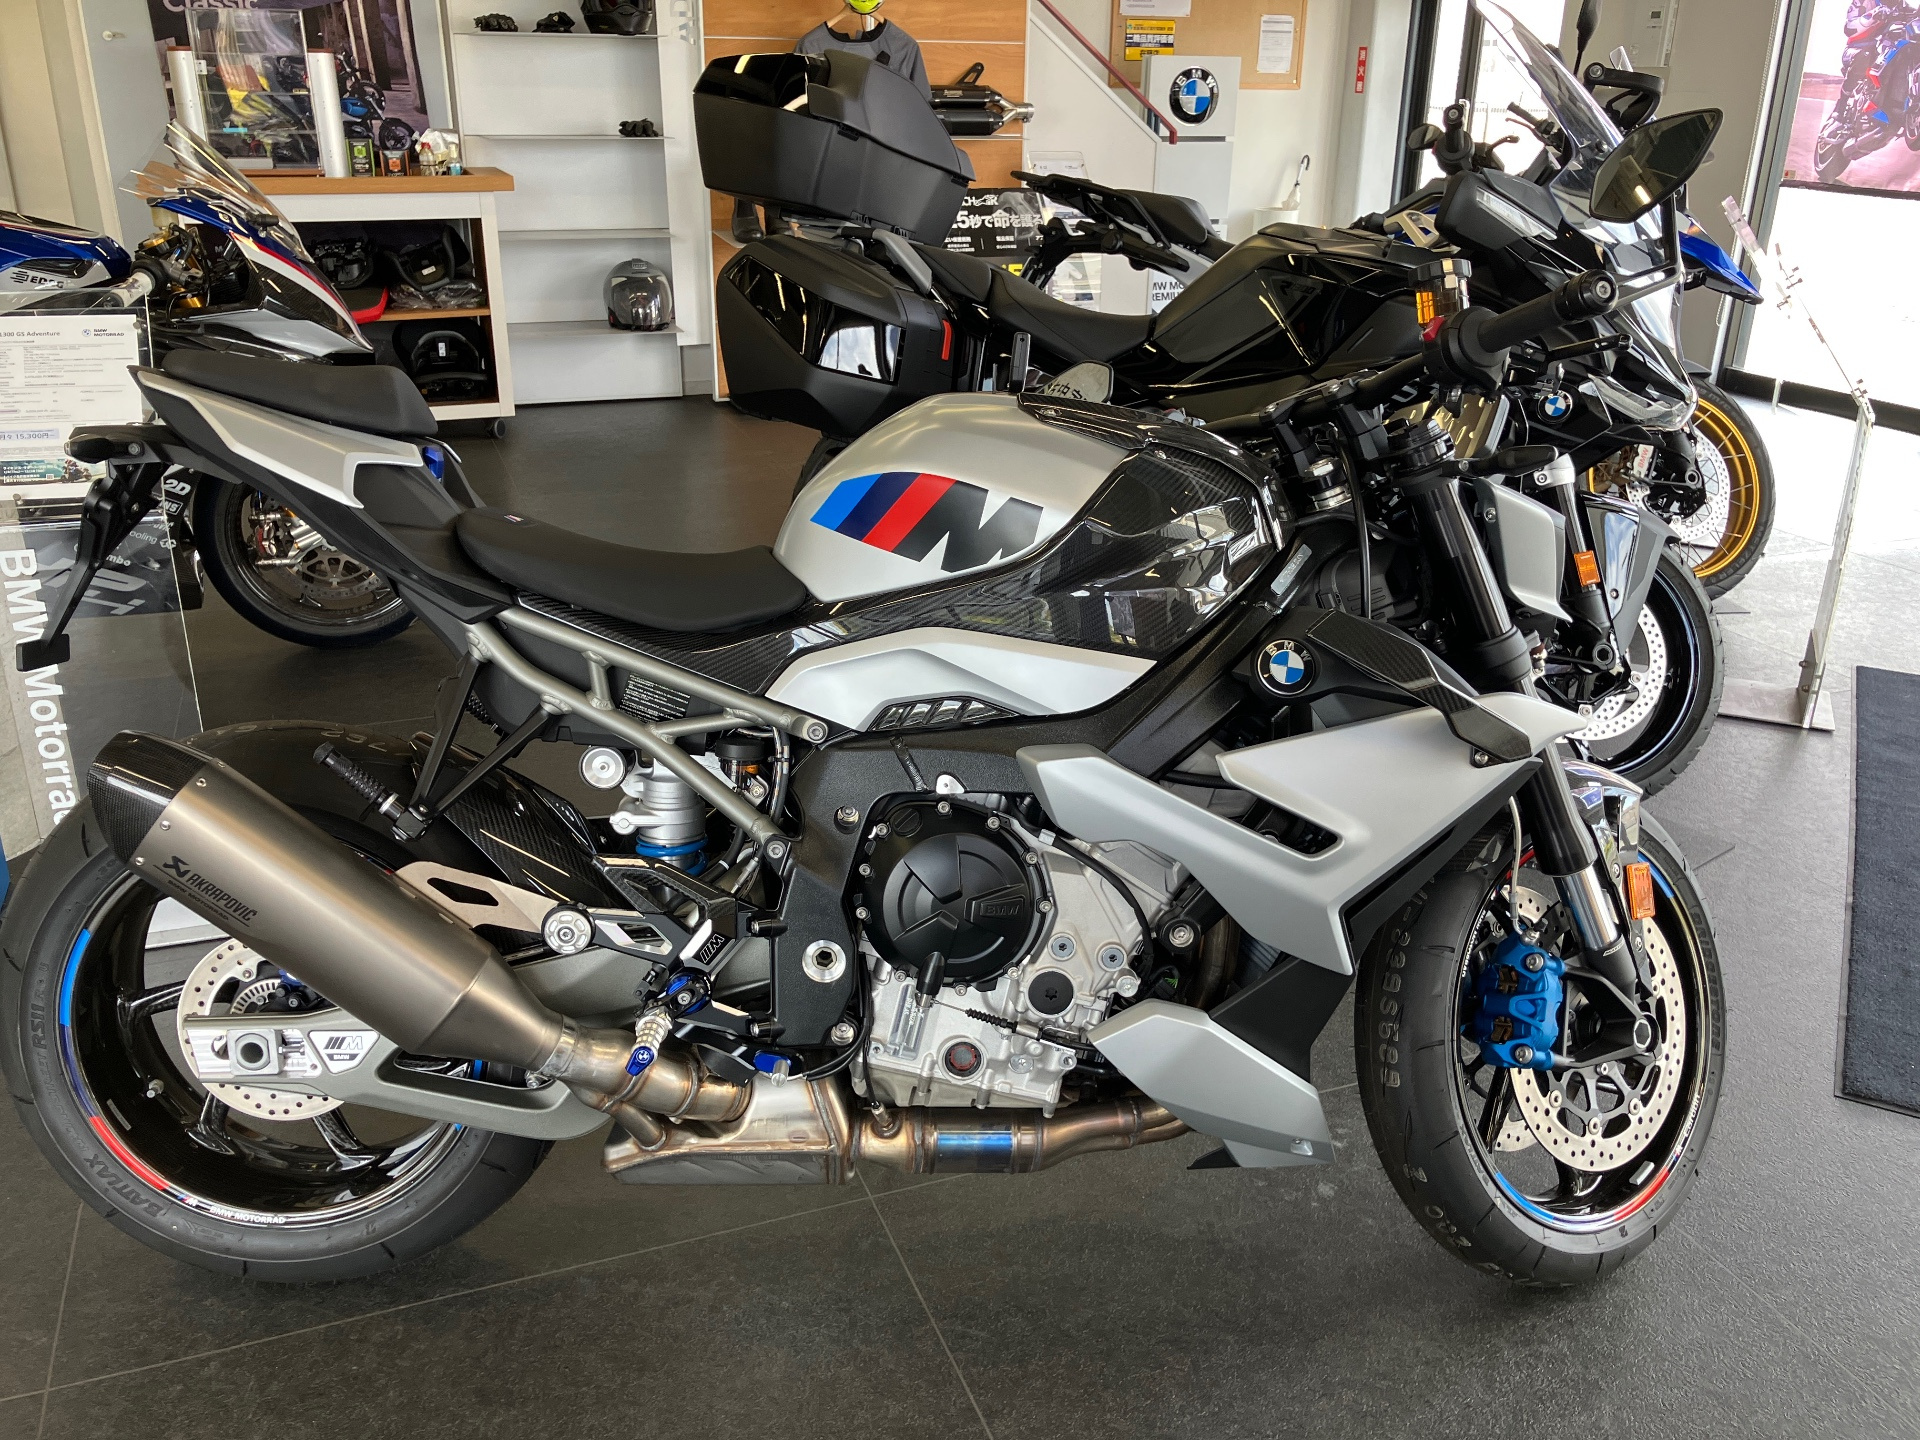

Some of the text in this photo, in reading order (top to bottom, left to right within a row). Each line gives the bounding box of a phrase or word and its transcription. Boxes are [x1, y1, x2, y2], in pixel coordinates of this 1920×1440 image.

[1638, 448, 1648, 469] BMW
[164, 479, 191, 496] 2D
[129, 530, 157, 544] ooling
[106, 553, 131, 567] mbo
[188, 892, 229, 920] MOTORRAD
[984, 903, 1020, 916] BMW
[84, 1154, 164, 1218] BATTLAX
[209, 1206, 286, 1224] BMW MOTORRAD
